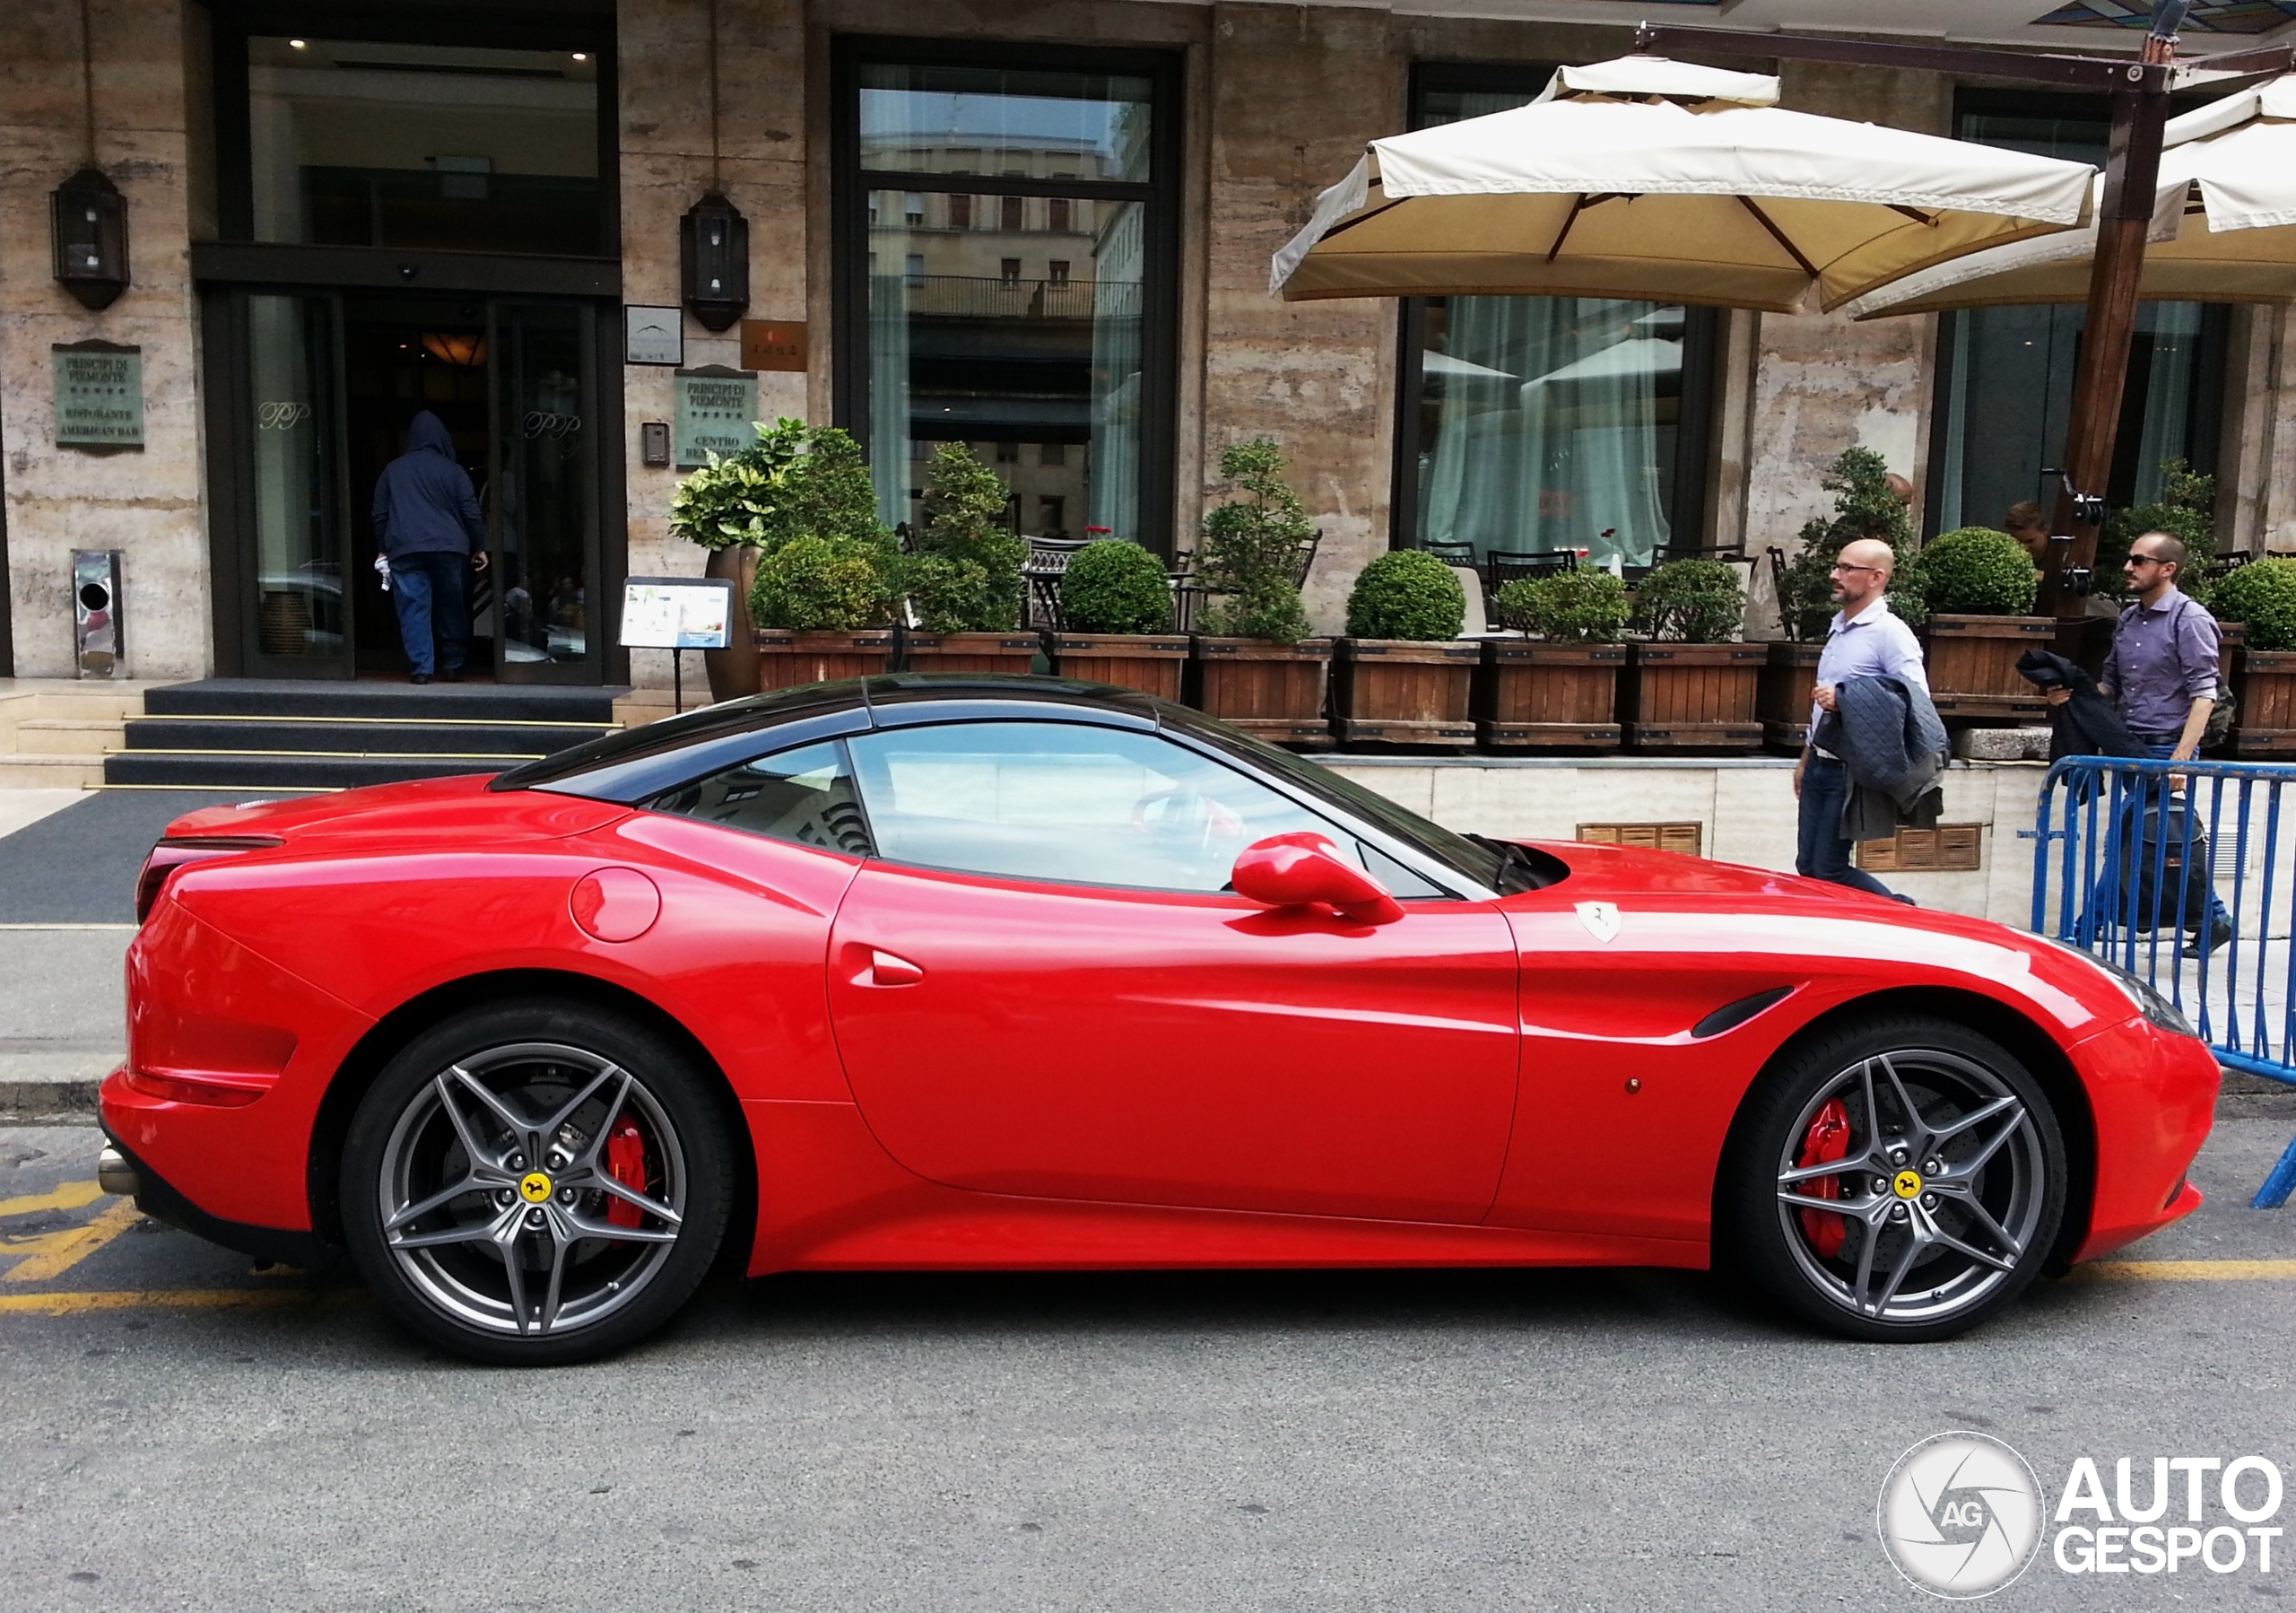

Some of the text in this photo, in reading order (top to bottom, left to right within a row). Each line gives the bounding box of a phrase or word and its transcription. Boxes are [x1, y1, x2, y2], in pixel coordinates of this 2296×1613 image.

[65, 358, 127, 371] PRINCIPI DI
[68, 370, 126, 383] PIEMONTE
[687, 382, 745, 396] PRINCIPI DI
[690, 395, 744, 407] PIEMONTE
[65, 408, 133, 420] RISTORANTE
[60, 425, 138, 436] AMERICAN BAR
[695, 436, 739, 446] CENTRO
